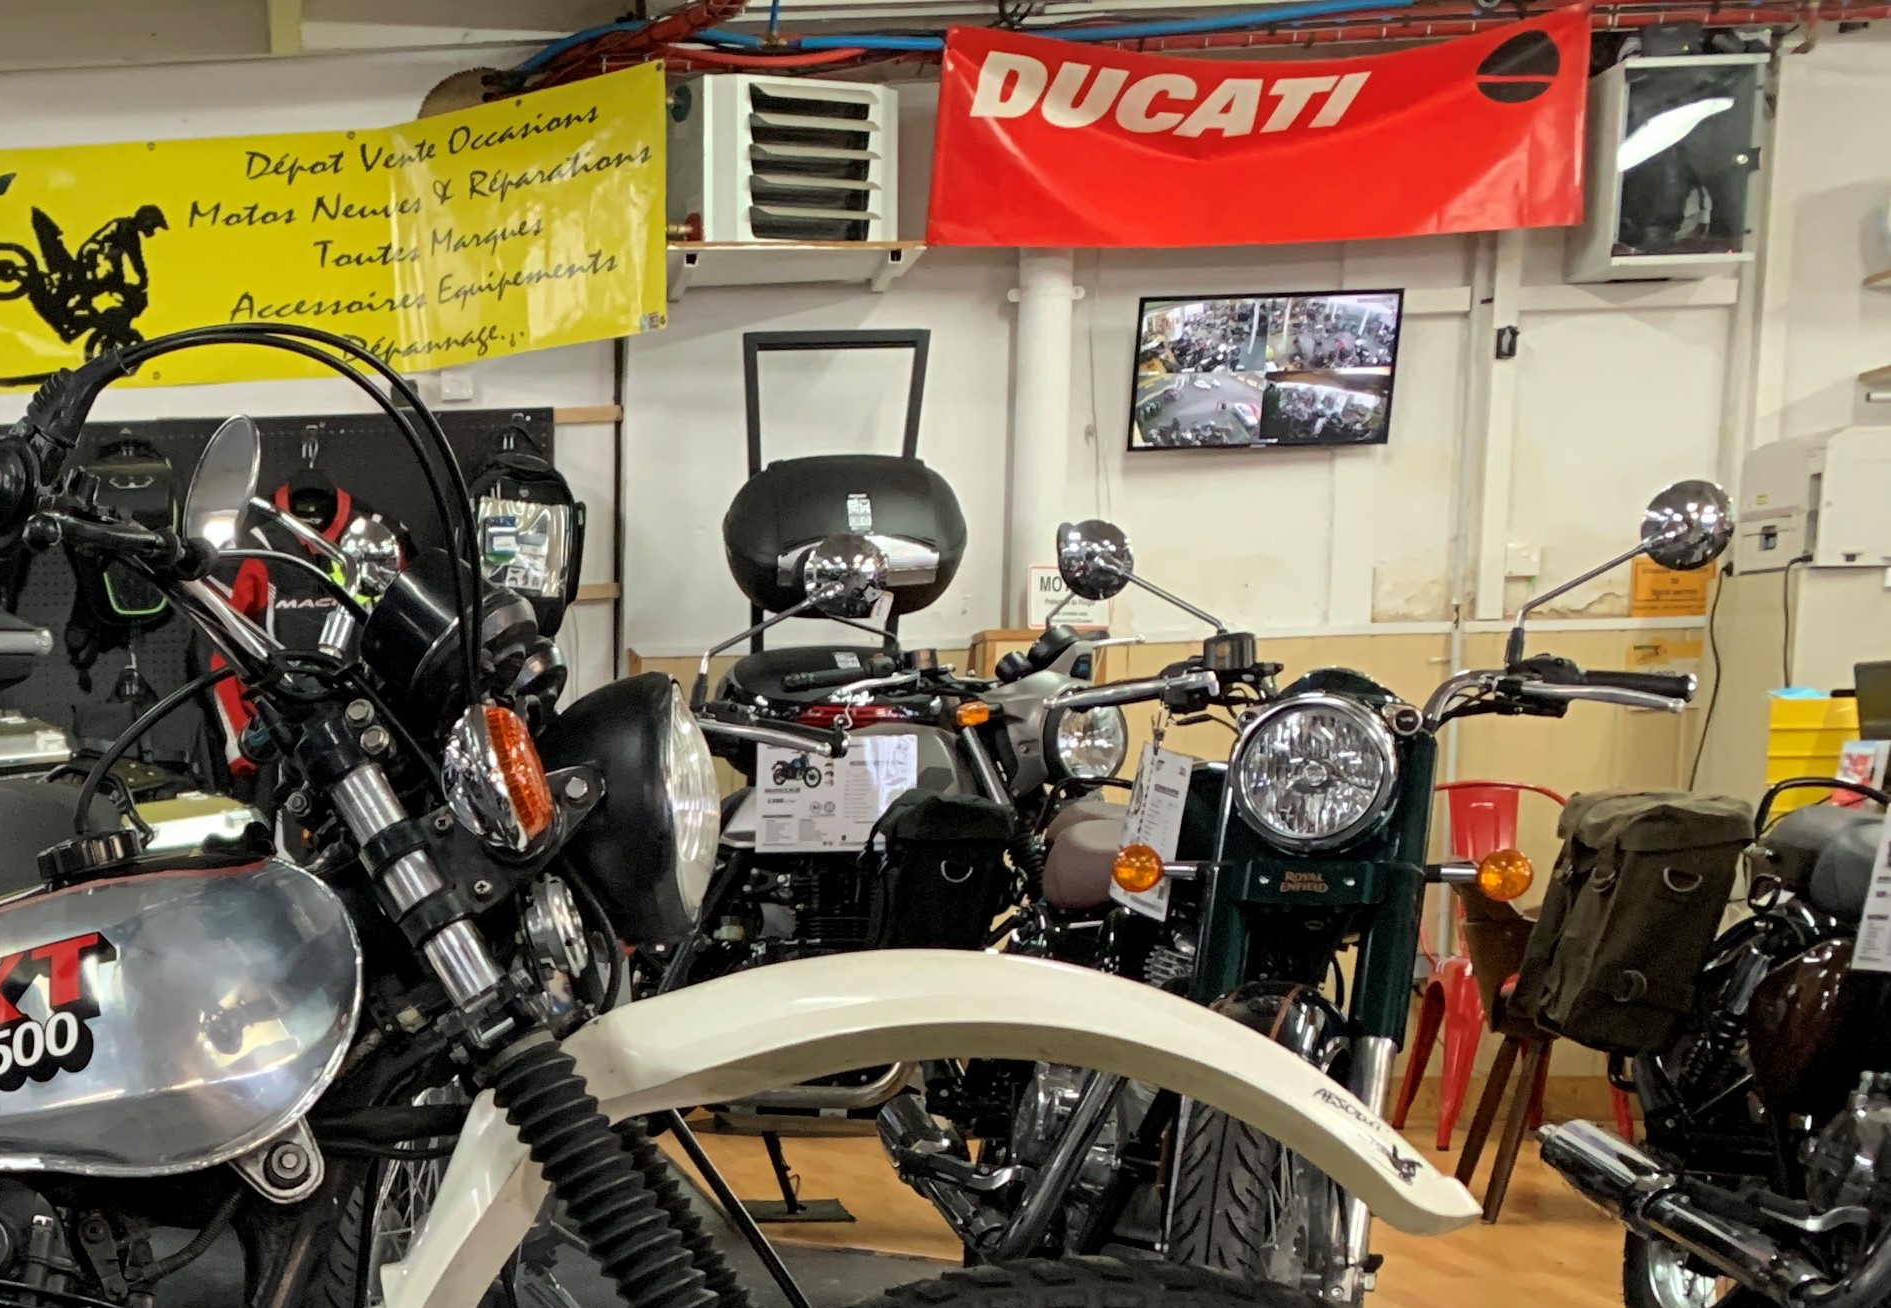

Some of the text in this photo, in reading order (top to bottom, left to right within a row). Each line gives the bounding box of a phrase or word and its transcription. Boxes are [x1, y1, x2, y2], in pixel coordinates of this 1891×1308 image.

[969, 50, 1372, 138] DUCATI
[360, 140, 436, 172] Vente
[448, 106, 599, 156] Occasions
[188, 144, 653, 228] Motos Neuves & Réparations
[313, 217, 544, 268] Toutes Marques
[229, 249, 619, 322] Accessoires Equipements
